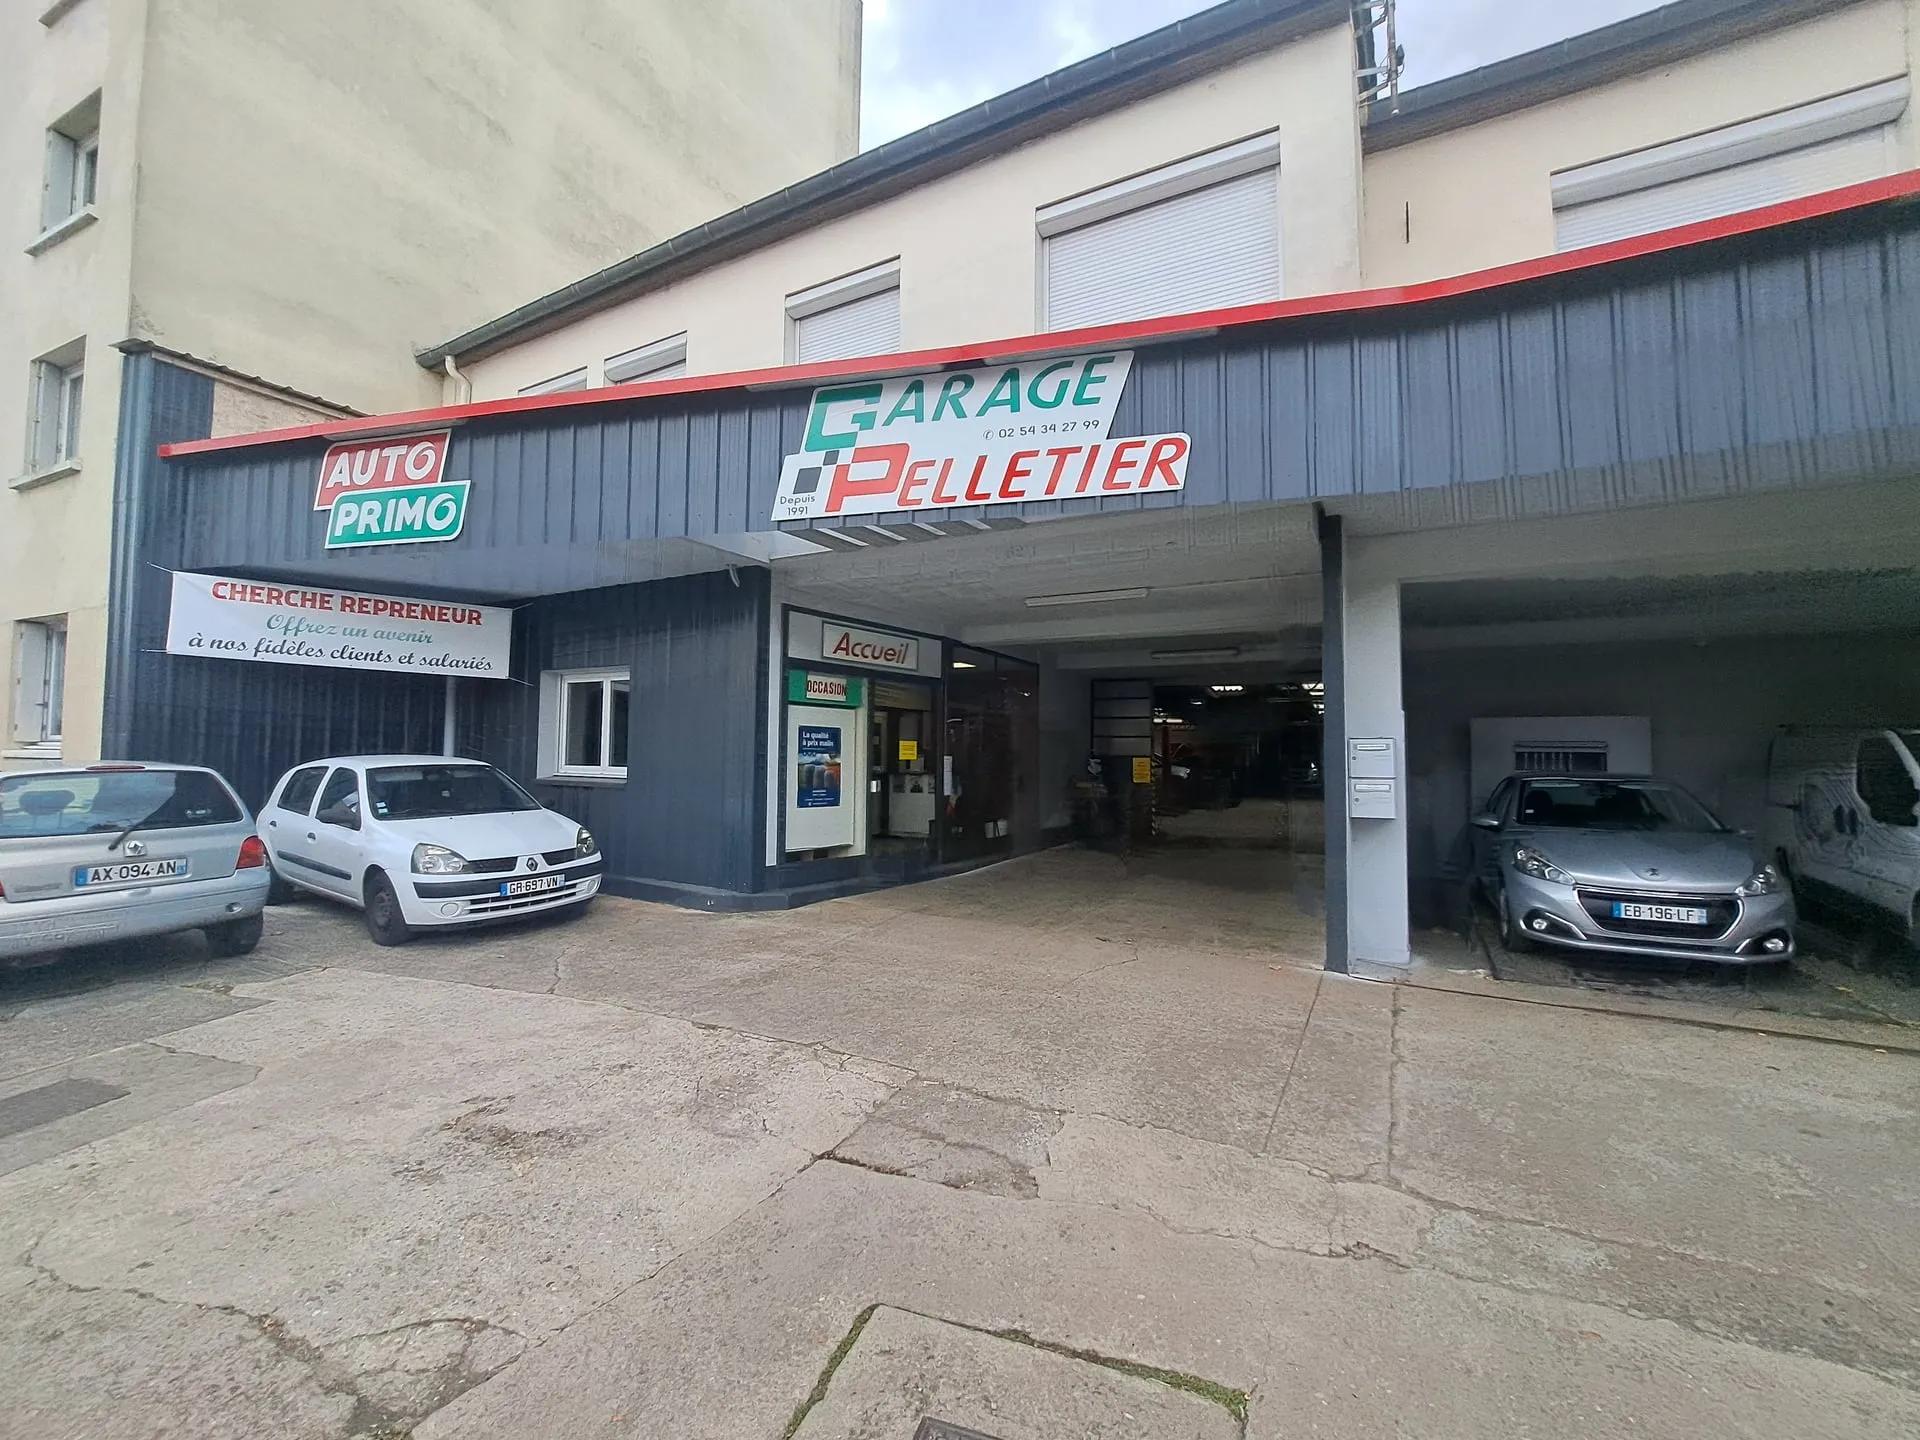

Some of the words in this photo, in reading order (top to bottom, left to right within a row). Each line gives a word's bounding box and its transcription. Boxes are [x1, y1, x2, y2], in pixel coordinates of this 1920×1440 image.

[804, 356, 1116, 452] GARAGE
[999, 428, 1015, 439] 02
[1019, 426, 1036, 437] 54
[1040, 424, 1057, 435] 34
[1062, 422, 1078, 432] 27
[1083, 419, 1100, 430] 99
[325, 441, 437, 489] AUTO
[824, 437, 1188, 513] PELLETIER
[780, 494, 816, 506] Depuis
[787, 505, 809, 516] 1991
[334, 492, 458, 537] PRIMO
[212, 581, 334, 611] CHERCHE
[340, 595, 482, 626] REPRENEUR
[266, 613, 338, 637] Offrez
[342, 626, 368, 638] un
[373, 629, 433, 644] avenir
[189, 632, 205, 648] à
[209, 638, 249, 651] nos
[253, 637, 326, 658] fidèles
[330, 644, 393, 663] clients
[398, 651, 416, 665] et
[419, 653, 494, 671] salariés
[832, 631, 909, 665] Accueil
[807, 680, 847, 697] OCCASION
[807, 739, 818, 747] prix
[91, 861, 177, 882] AX-094-AN
[509, 877, 558, 894] GR-697-VN
[1624, 904, 1695, 921] EB-196-LF
